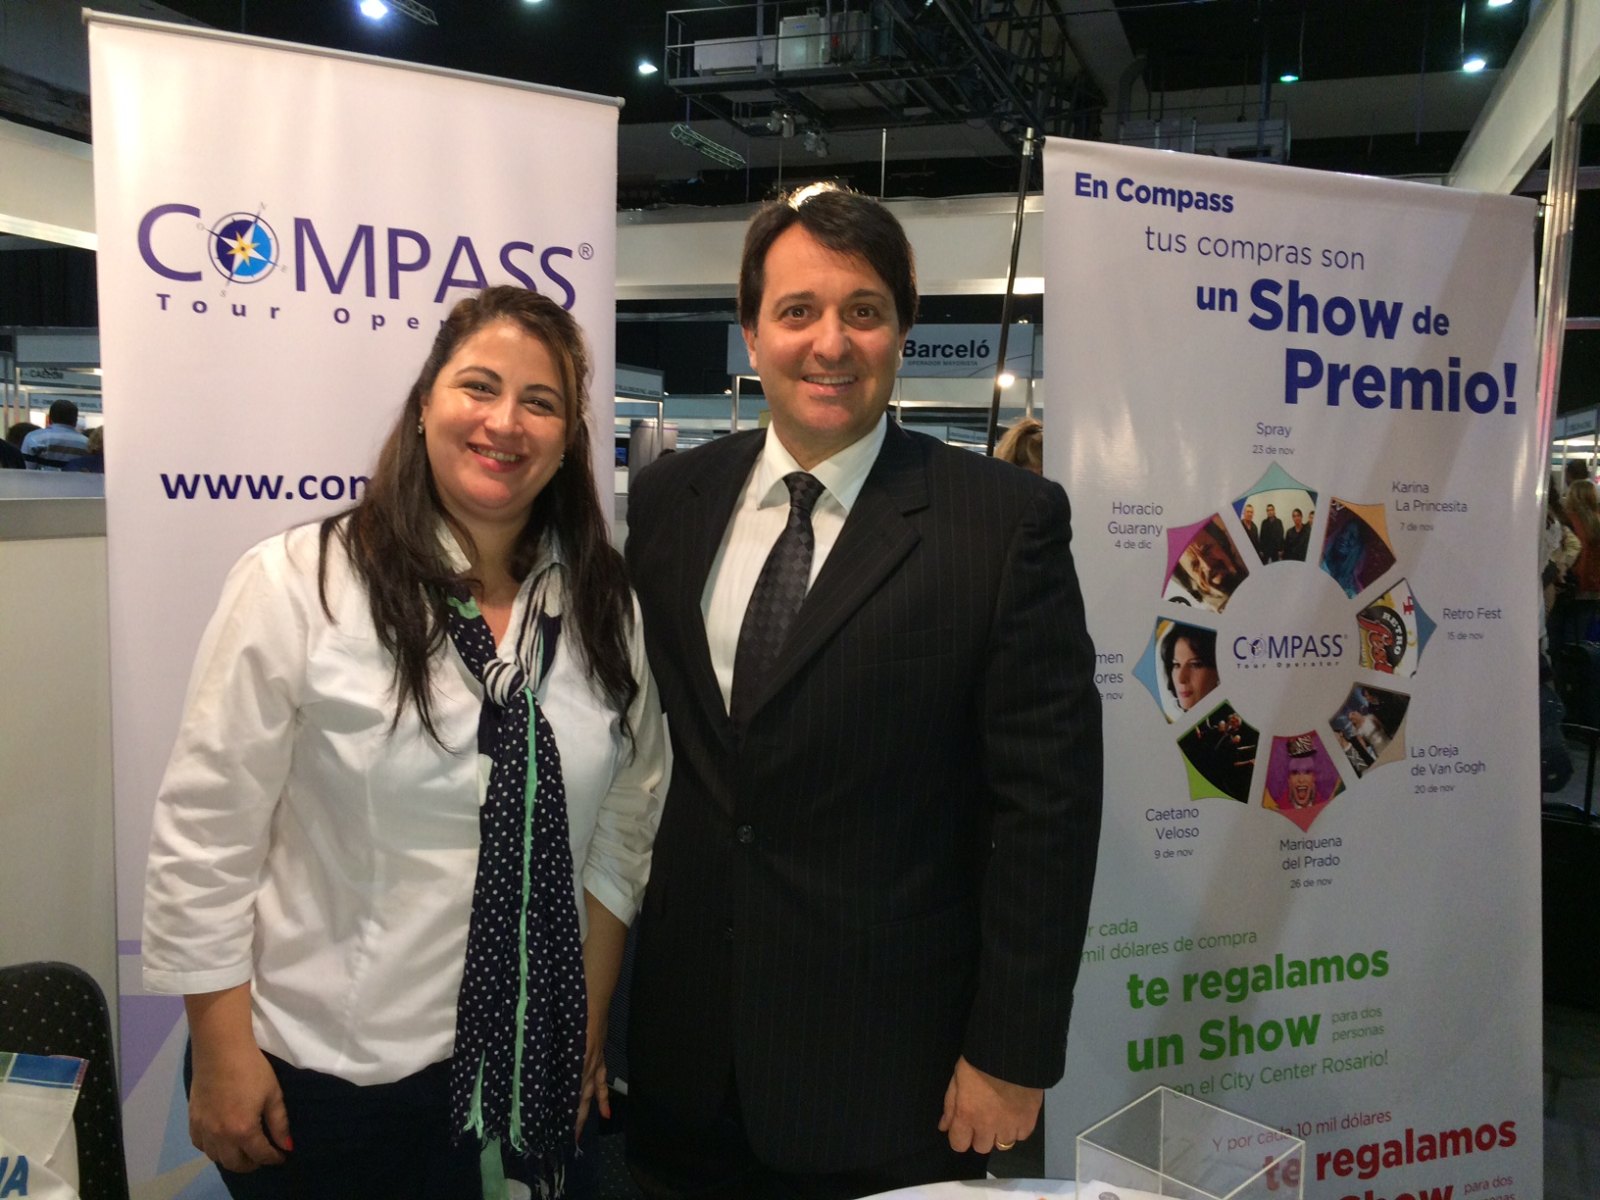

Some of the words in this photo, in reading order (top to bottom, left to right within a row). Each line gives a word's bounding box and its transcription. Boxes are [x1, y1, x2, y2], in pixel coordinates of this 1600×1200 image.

[1075, 172, 1108, 200] En
[1115, 177, 1234, 213] Compass
[1145, 225, 1187, 254] tus
[1197, 235, 1312, 267] compras
[1321, 247, 1365, 270] son
[156, 293, 281, 319] Tour
[1196, 285, 1238, 312] un
[1248, 278, 1404, 340] Show
[1412, 306, 1450, 336] de
[903, 339, 990, 359] Barceló
[1284, 348, 1517, 415] Premio!
[1256, 422, 1292, 438] Spray
[1252, 445, 1264, 455] 23
[1265, 445, 1277, 455] de
[1278, 446, 1295, 456] nov
[1392, 481, 1430, 495] Karina
[1112, 502, 1164, 517] Horacio
[1395, 499, 1411, 512] La
[1413, 499, 1468, 514] Princesita
[1108, 521, 1164, 539] Guarany
[1407, 522, 1417, 532] de
[1419, 524, 1434, 532] nov
[1115, 540, 1121, 549] 4
[1124, 540, 1137, 550] de
[1138, 540, 1152, 550] dic
[1443, 608, 1474, 621] Retro
[1476, 607, 1502, 620] Fest
[1457, 631, 1467, 641] de
[1469, 632, 1485, 641] nov
[1094, 672, 1124, 685] ores
[1105, 692, 1124, 700] nov
[1411, 746, 1426, 759] La
[1429, 744, 1459, 760] Oreja
[1411, 763, 1426, 777] de
[1428, 762, 1452, 776] Van
[1454, 760, 1486, 778] Gogh
[1415, 784, 1425, 794] 20
[1426, 784, 1437, 794] de
[1438, 785, 1456, 793] nov
[1145, 806, 1200, 823] Caetano
[1155, 826, 1200, 841] Veloso
[1280, 835, 1343, 854] Mariquena
[1154, 850, 1161, 859] 9
[1163, 849, 1175, 859] de
[1176, 849, 1194, 859] nov
[1282, 856, 1301, 871] del
[1304, 854, 1341, 870] Prado
[1290, 879, 1302, 889] 26
[1303, 878, 1314, 888] de
[1316, 877, 1333, 887] nov
[1099, 918, 1138, 937] cada
[1081, 945, 1105, 964] mil
[1110, 941, 1169, 960] dólares
[1174, 935, 1194, 952] de
[1198, 931, 1257, 950] compra
[1126, 972, 1169, 1009] te
[1183, 949, 1390, 1004] regalamos
[1332, 1007, 1358, 1025] para
[1360, 1005, 1383, 1020] dos
[1127, 1029, 1184, 1073] un
[1199, 1012, 1322, 1061] Show
[1332, 1023, 1385, 1044] personas
[1173, 1083, 1194, 1098] en
[1200, 1079, 1214, 1094] el
[1220, 1071, 1254, 1091] City
[1260, 1064, 1317, 1084] Center
[1323, 1049, 1389, 1074] Rosario!
[1212, 1138, 1224, 1152] Y
[1228, 1133, 1253, 1152] por
[1258, 1124, 1292, 1145] cada
[1297, 1121, 1312, 1138] 10
[1316, 1118, 1337, 1134] mil
[1341, 1110, 1392, 1131] dólares
[1263, 1155, 1300, 1192] te
[1316, 1120, 1517, 1181] regalamos
[1463, 1179, 1489, 1195] para
[1492, 1175, 1514, 1189] dos
